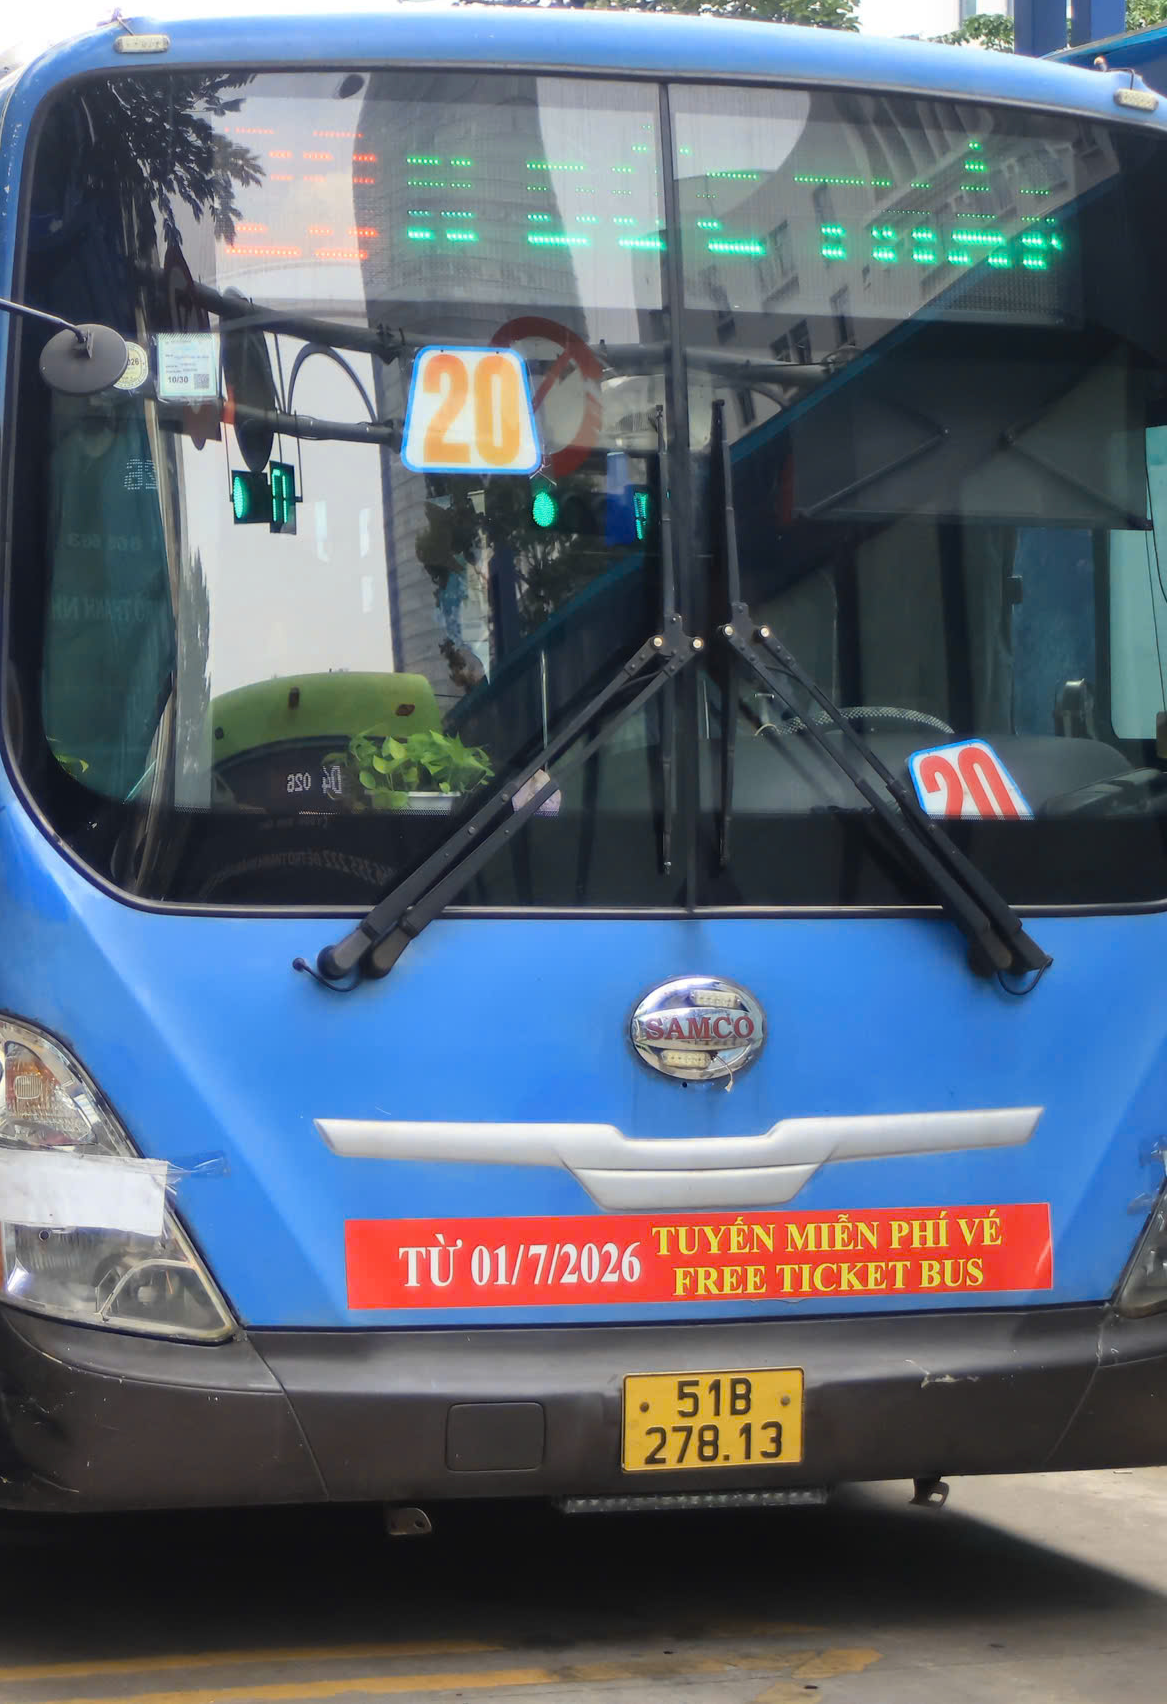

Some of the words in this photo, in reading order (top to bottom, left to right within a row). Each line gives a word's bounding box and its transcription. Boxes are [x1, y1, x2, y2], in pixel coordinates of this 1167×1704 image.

[423, 354, 521, 466] 20
[920, 748, 1020, 820] 20
[645, 1014, 755, 1041] SAMCO
[651, 1216, 775, 1255] TUYẾN
[785, 1213, 880, 1252] MIỄN
[889, 1210, 950, 1249] PHÍ
[956, 1209, 1002, 1246] VÉ
[398, 1234, 463, 1287] TỪ
[471, 1242, 641, 1286] 01/7/2026
[672, 1265, 767, 1296] FREE
[776, 1260, 911, 1292] TICKET
[919, 1257, 983, 1288] BUS
[677, 1377, 752, 1418] 51B
[644, 1421, 784, 1466] 278.13
